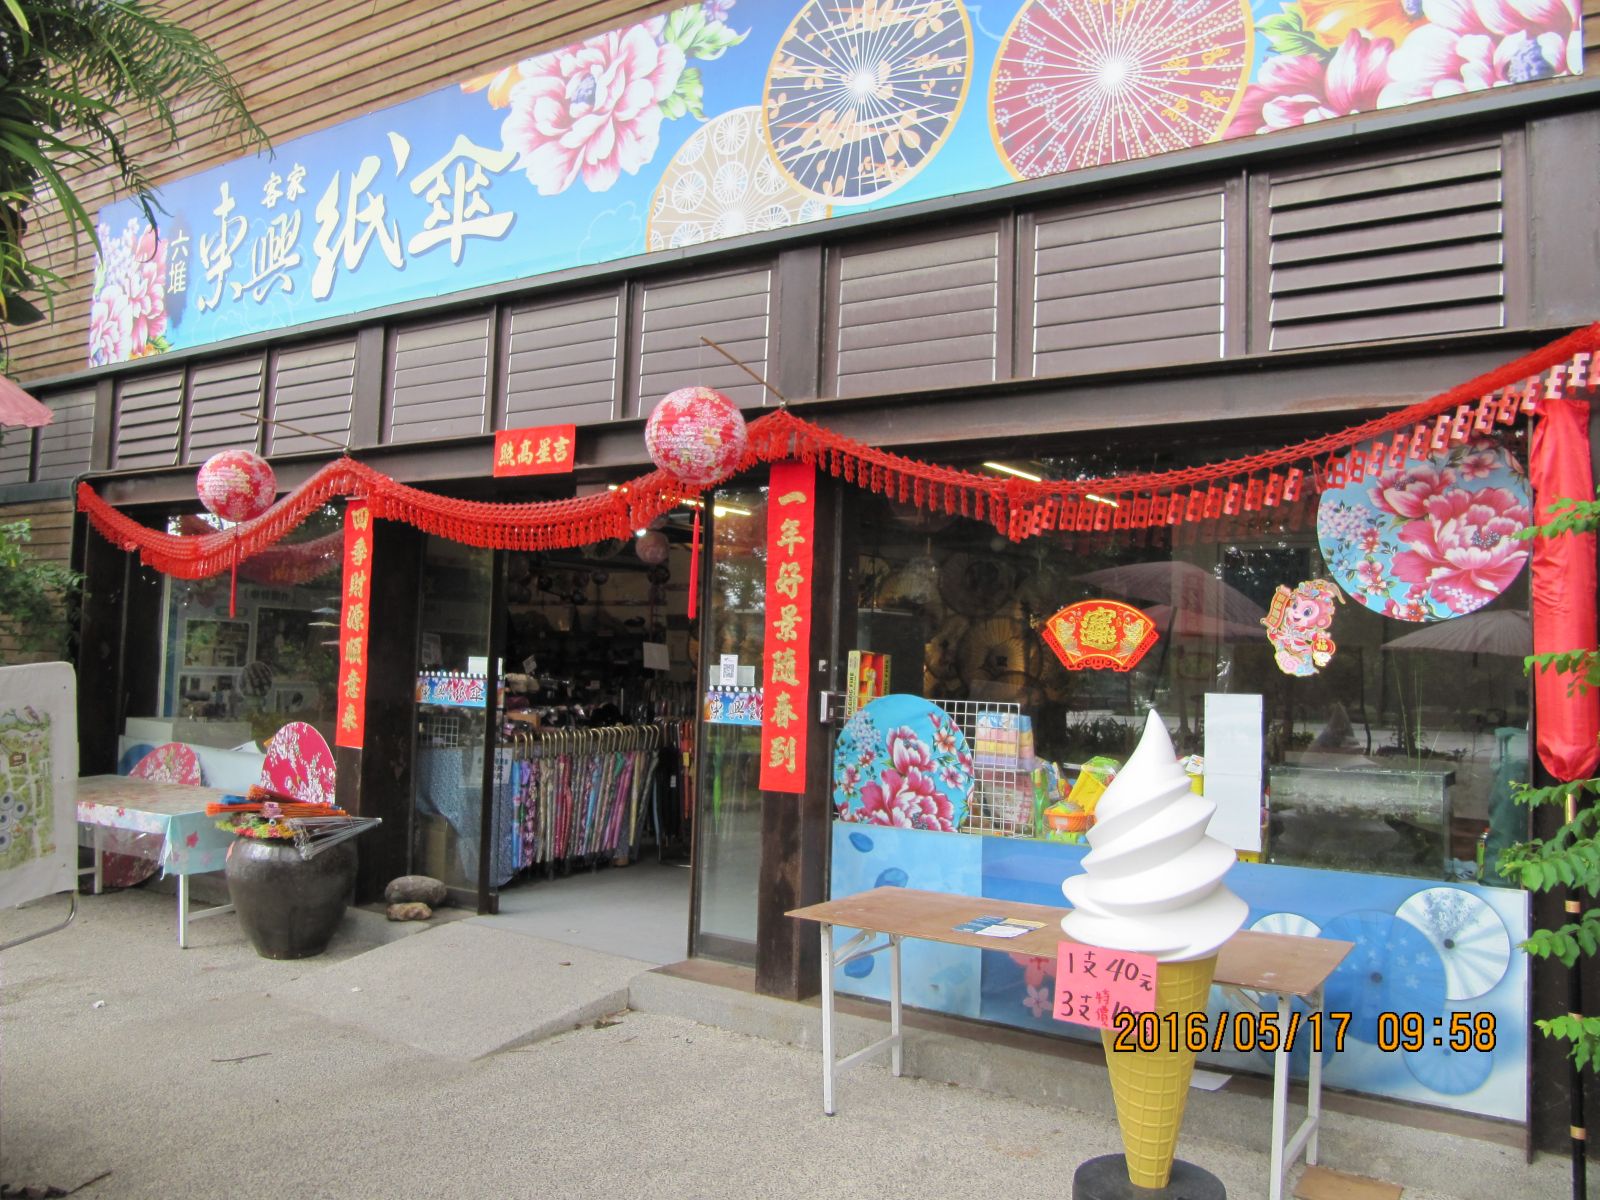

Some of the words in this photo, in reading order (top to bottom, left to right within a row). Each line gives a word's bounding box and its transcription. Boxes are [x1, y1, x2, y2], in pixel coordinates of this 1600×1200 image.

[260, 163, 306, 209] 客家
[168, 229, 190, 294] 六堆
[768, 490, 807, 774] 一年好景隨春到
